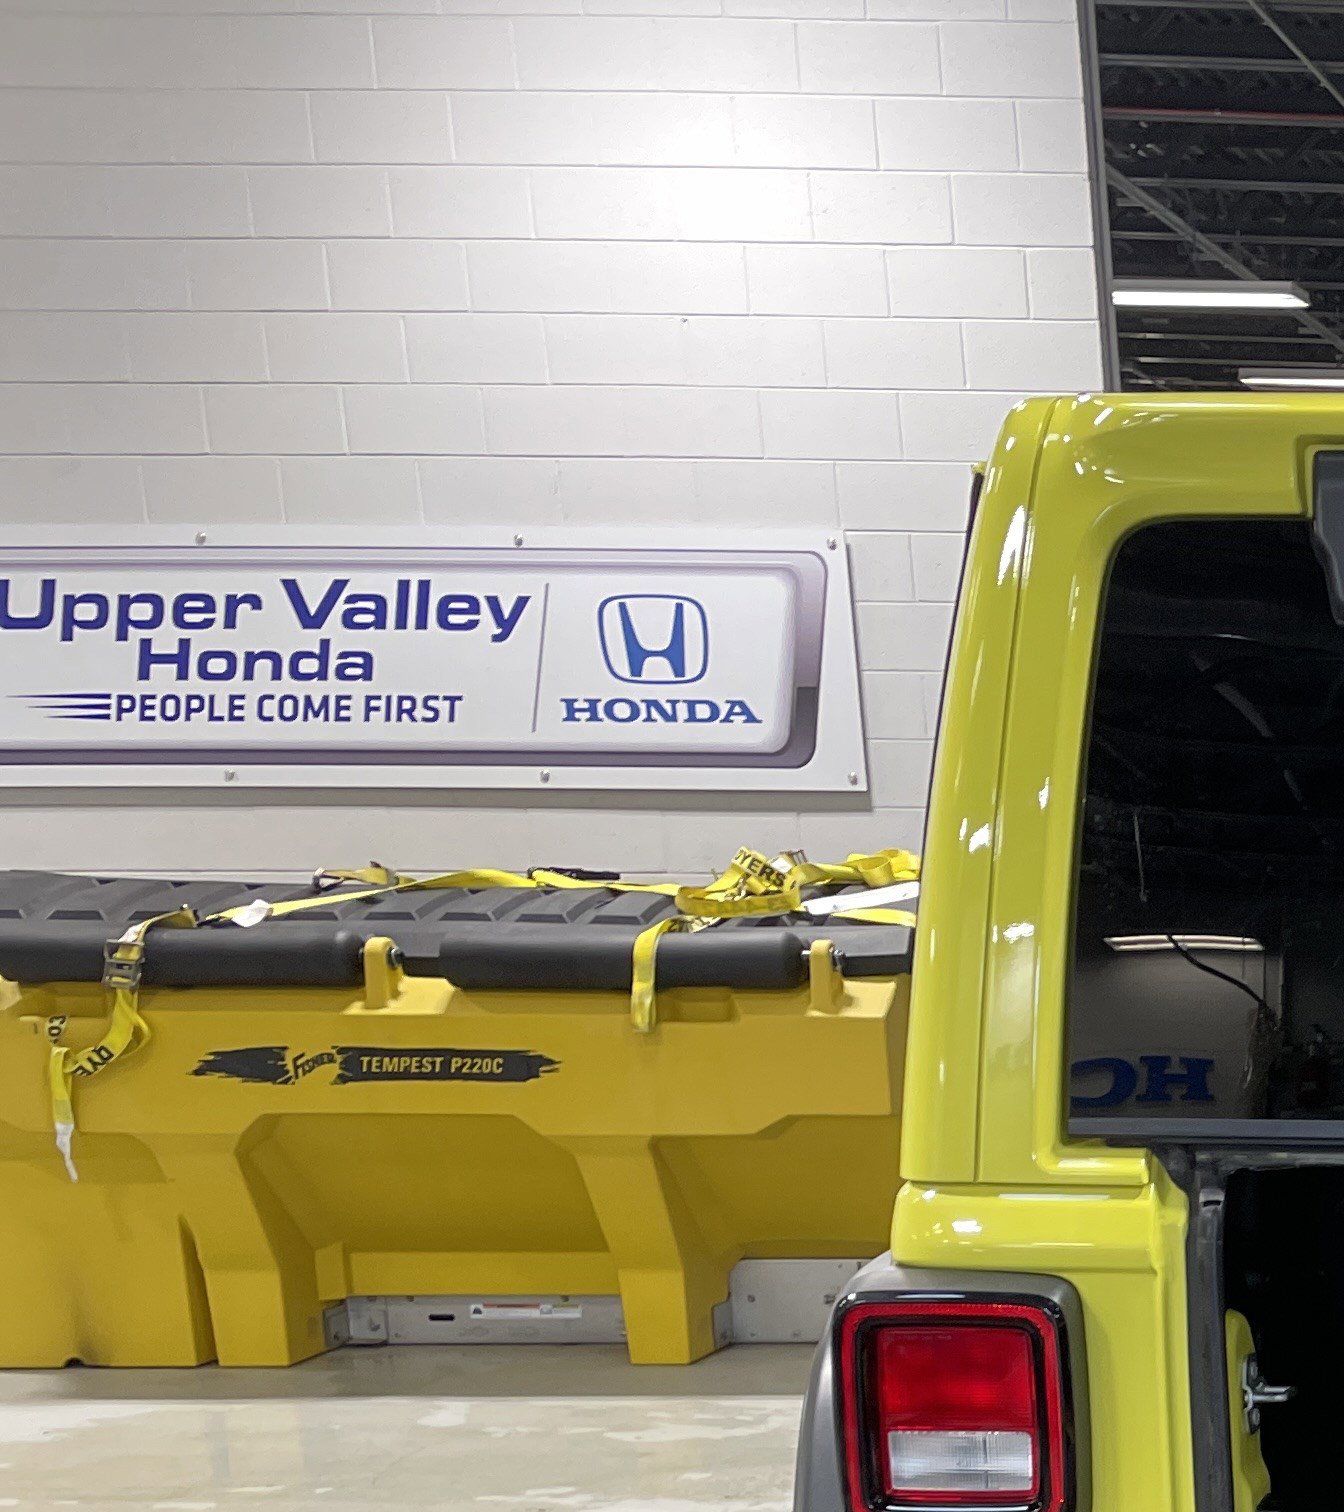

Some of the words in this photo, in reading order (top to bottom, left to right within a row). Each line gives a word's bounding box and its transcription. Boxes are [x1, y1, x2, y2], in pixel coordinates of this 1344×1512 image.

[0, 578, 263, 642] Upper
[279, 578, 533, 643] Valley
[137, 637, 374, 682] Honda
[115, 694, 247, 722] PEOPLE
[256, 694, 352, 723] COME
[363, 695, 464, 723] FIRST
[560, 698, 763, 723] HONDA
[359, 1056, 445, 1074] TEMPEST
[450, 1056, 504, 1074] P220C
